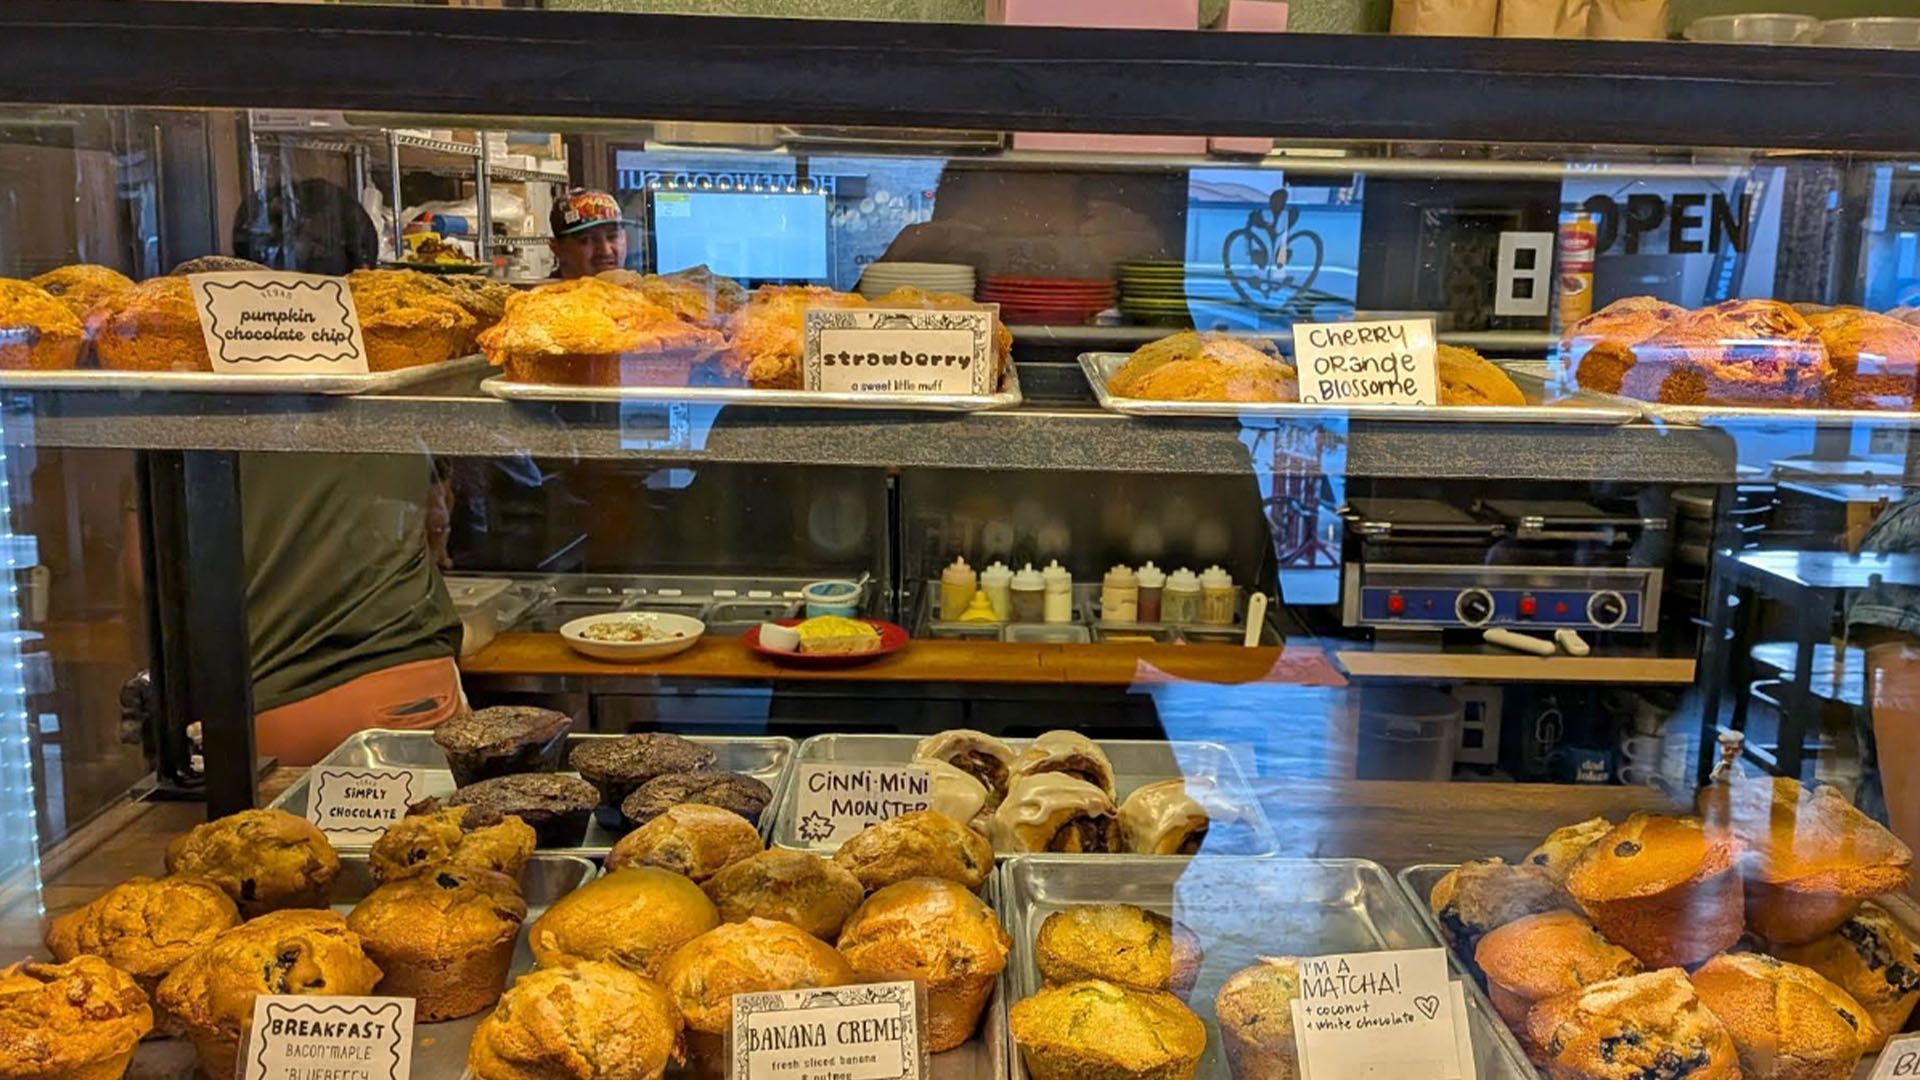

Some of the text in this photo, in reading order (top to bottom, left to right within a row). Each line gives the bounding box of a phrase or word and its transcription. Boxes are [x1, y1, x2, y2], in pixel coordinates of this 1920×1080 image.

[1583, 193, 1752, 254] OPEN
[240, 308, 315, 325] pumpkin
[225, 326, 347, 346] chocolate chip
[823, 351, 972, 370] strawberry
[851, 379, 943, 391] a sweet little muff
[329, 806, 397, 820] CHOCOLATE
[1303, 958, 1351, 977] I'M A
[1303, 963, 1403, 1000] MATCHA!
[1316, 1000, 1370, 1016] coconut
[271, 1019, 386, 1040] BREAKFAST
[1315, 1017, 1352, 1031] white
[1356, 1012, 1415, 1030] chocolate
[750, 1017, 902, 1051] BANANA CREME
[771, 1055, 877, 1071] fresh sliced banana
